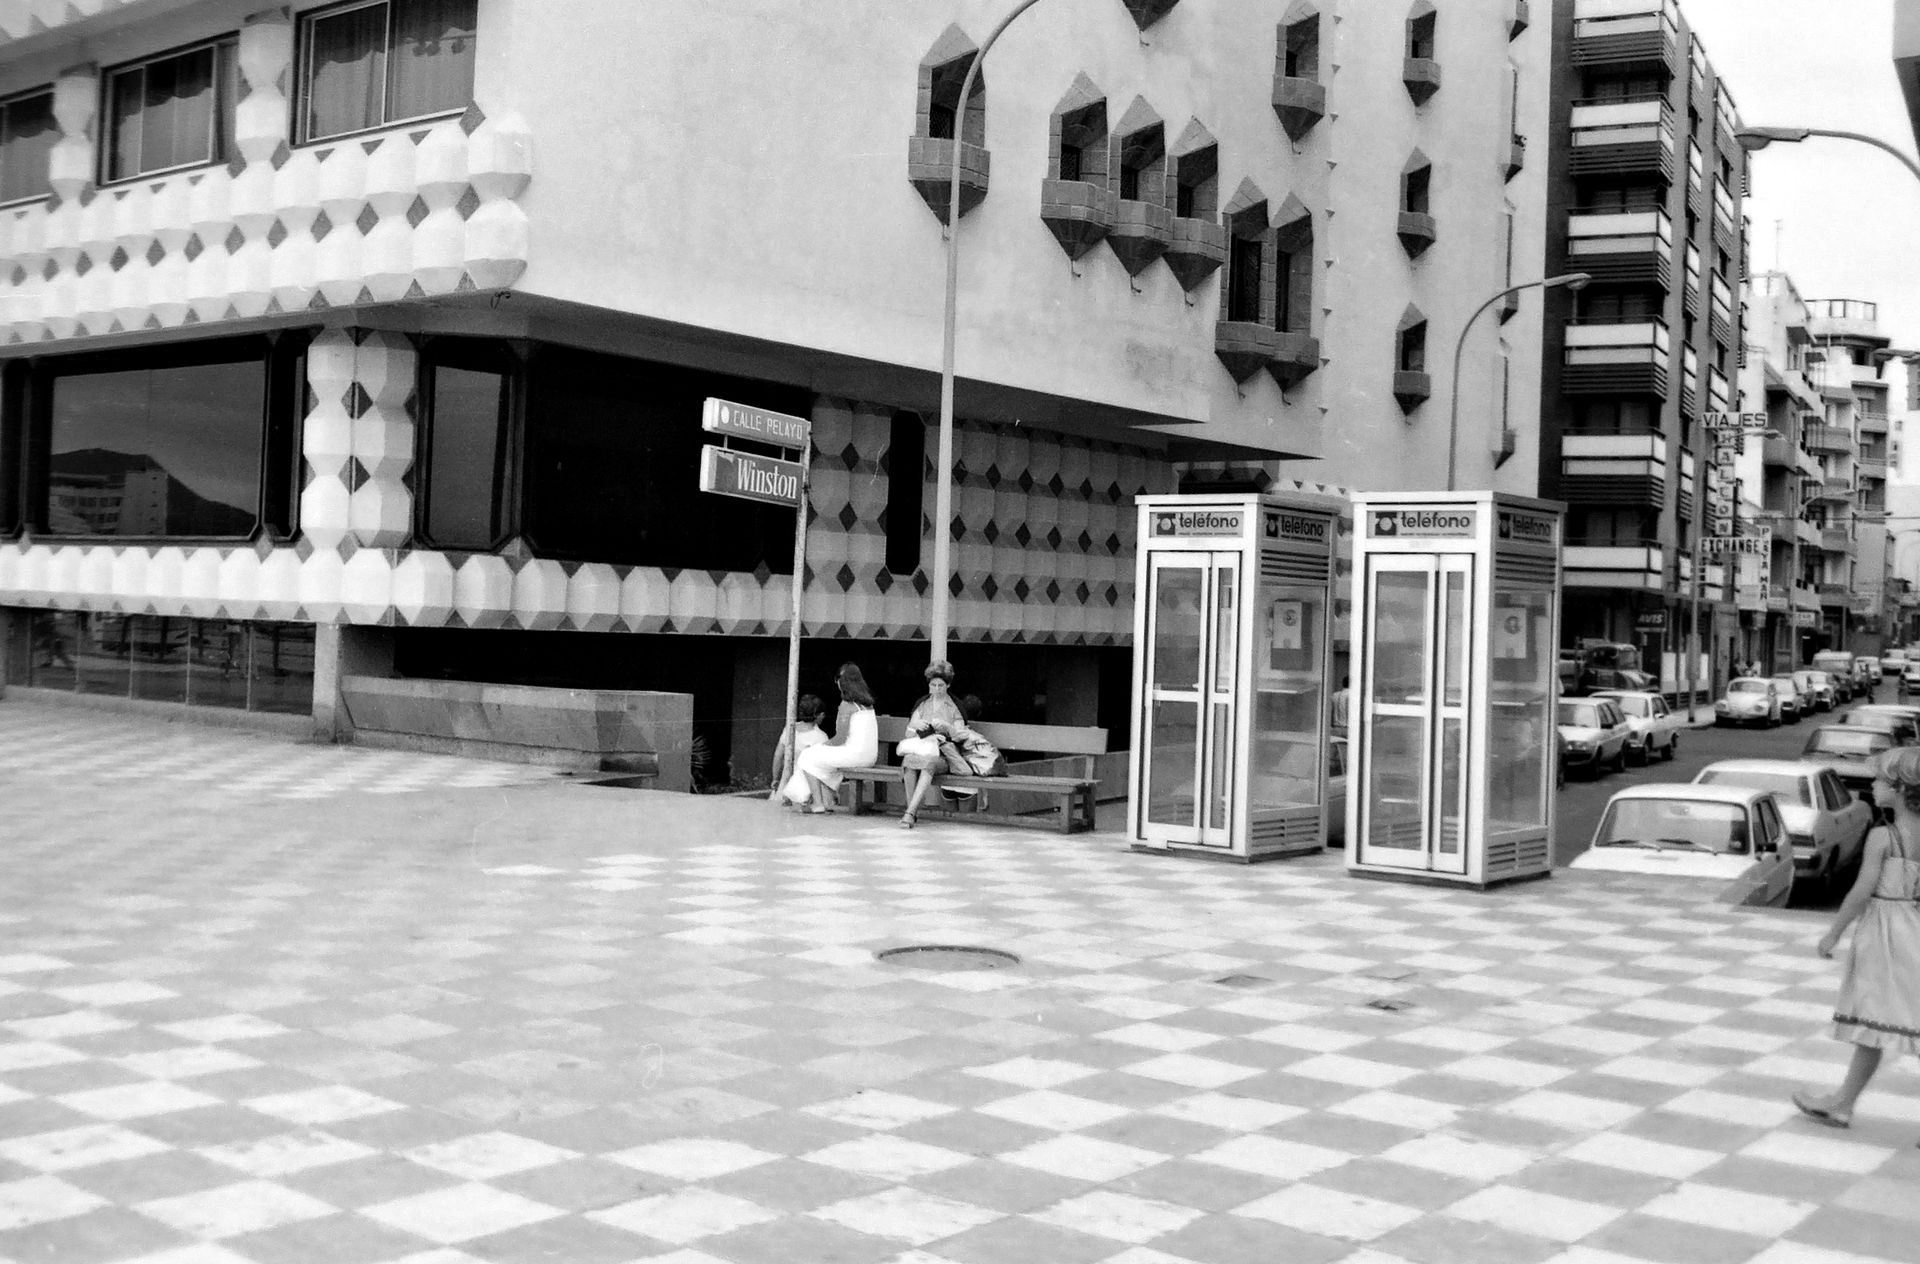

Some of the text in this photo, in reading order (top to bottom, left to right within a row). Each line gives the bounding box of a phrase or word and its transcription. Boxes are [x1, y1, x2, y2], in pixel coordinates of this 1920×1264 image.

[733, 410, 803, 440] CALLE PELAYO
[1703, 413, 1766, 427] VIAJES
[737, 458, 797, 499] Winston
[1179, 512, 1239, 528] teléfono
[1281, 516, 1324, 536] teléfono
[1401, 511, 1470, 528] teléfono
[1701, 539, 1760, 553] EXCHANGE
[1637, 614, 1664, 624] AVIS
